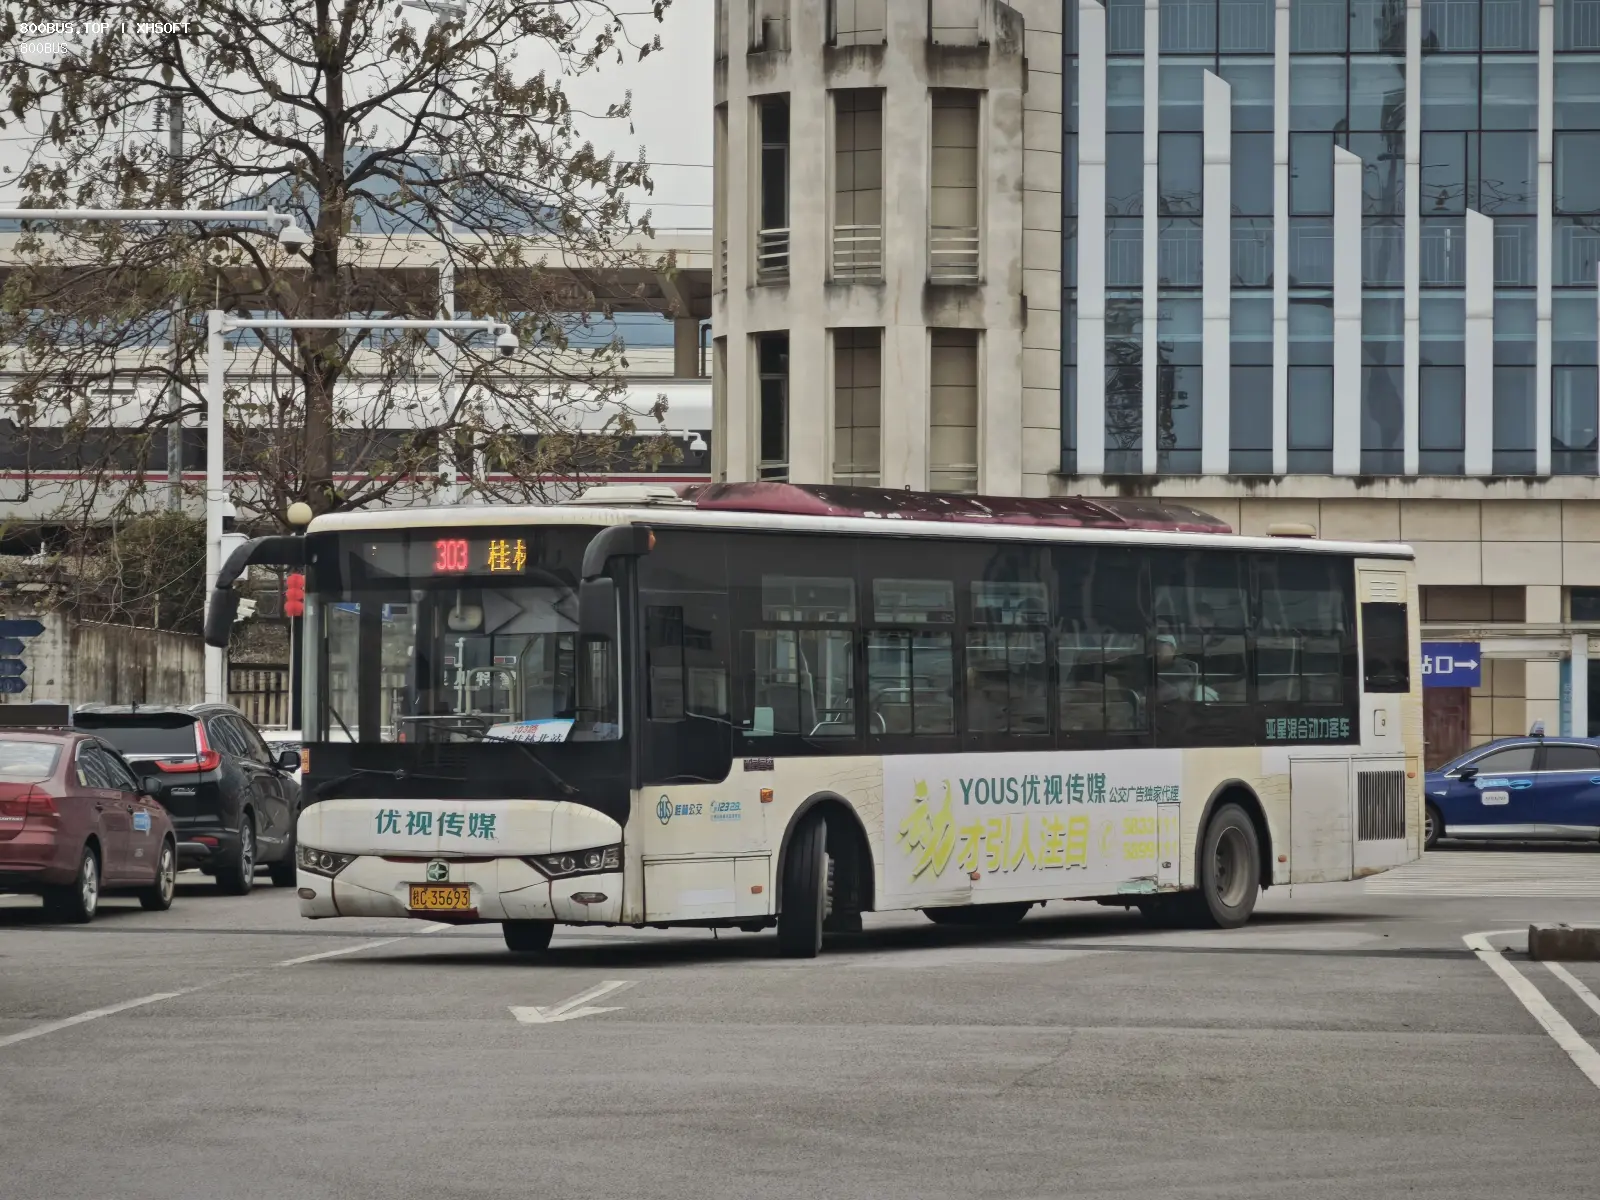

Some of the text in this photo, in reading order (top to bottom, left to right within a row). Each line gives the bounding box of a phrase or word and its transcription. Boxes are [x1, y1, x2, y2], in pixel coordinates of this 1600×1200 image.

[434, 539, 469, 571] 303
[1265, 717, 1350, 739] 亚星混合动力客车
[958, 773, 1180, 806] YOUS优视传媒 公交广告独家代理
[375, 808, 497, 839] 优视传媒
